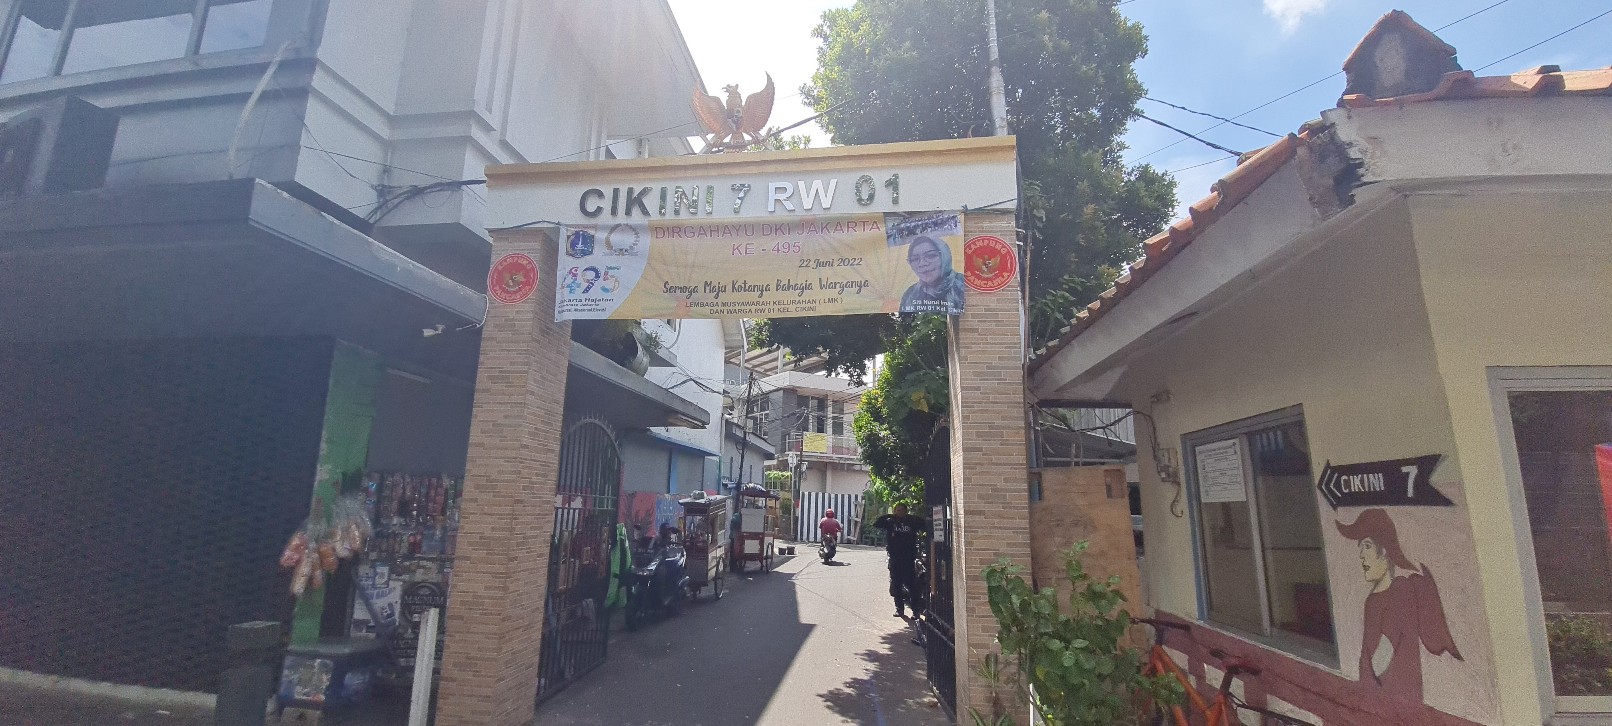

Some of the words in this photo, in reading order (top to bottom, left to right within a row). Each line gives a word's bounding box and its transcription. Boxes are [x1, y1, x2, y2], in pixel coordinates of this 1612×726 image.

[579, 184, 714, 218] CIKINI
[730, 183, 751, 214] 7
[767, 178, 838, 212] RW
[854, 173, 900, 206] 01
[654, 223, 755, 239] DIRGAHAYU
[761, 223, 791, 236] DKI
[796, 220, 881, 236] JAKARTA
[731, 243, 755, 256] KE
[771, 241, 801, 254] 495
[798, 258, 811, 268] 22
[812, 258, 835, 269] Juni
[836, 257, 863, 267] 2022
[662, 281, 699, 299] Semoga
[703, 280, 727, 299] Maju
[731, 279, 771, 298] Kotanya
[775, 278, 814, 297] Bahagia
[818, 276, 870, 294] Warganya
[1340, 473, 1385, 493] CIKINI
[1401, 465, 1418, 498] 7
